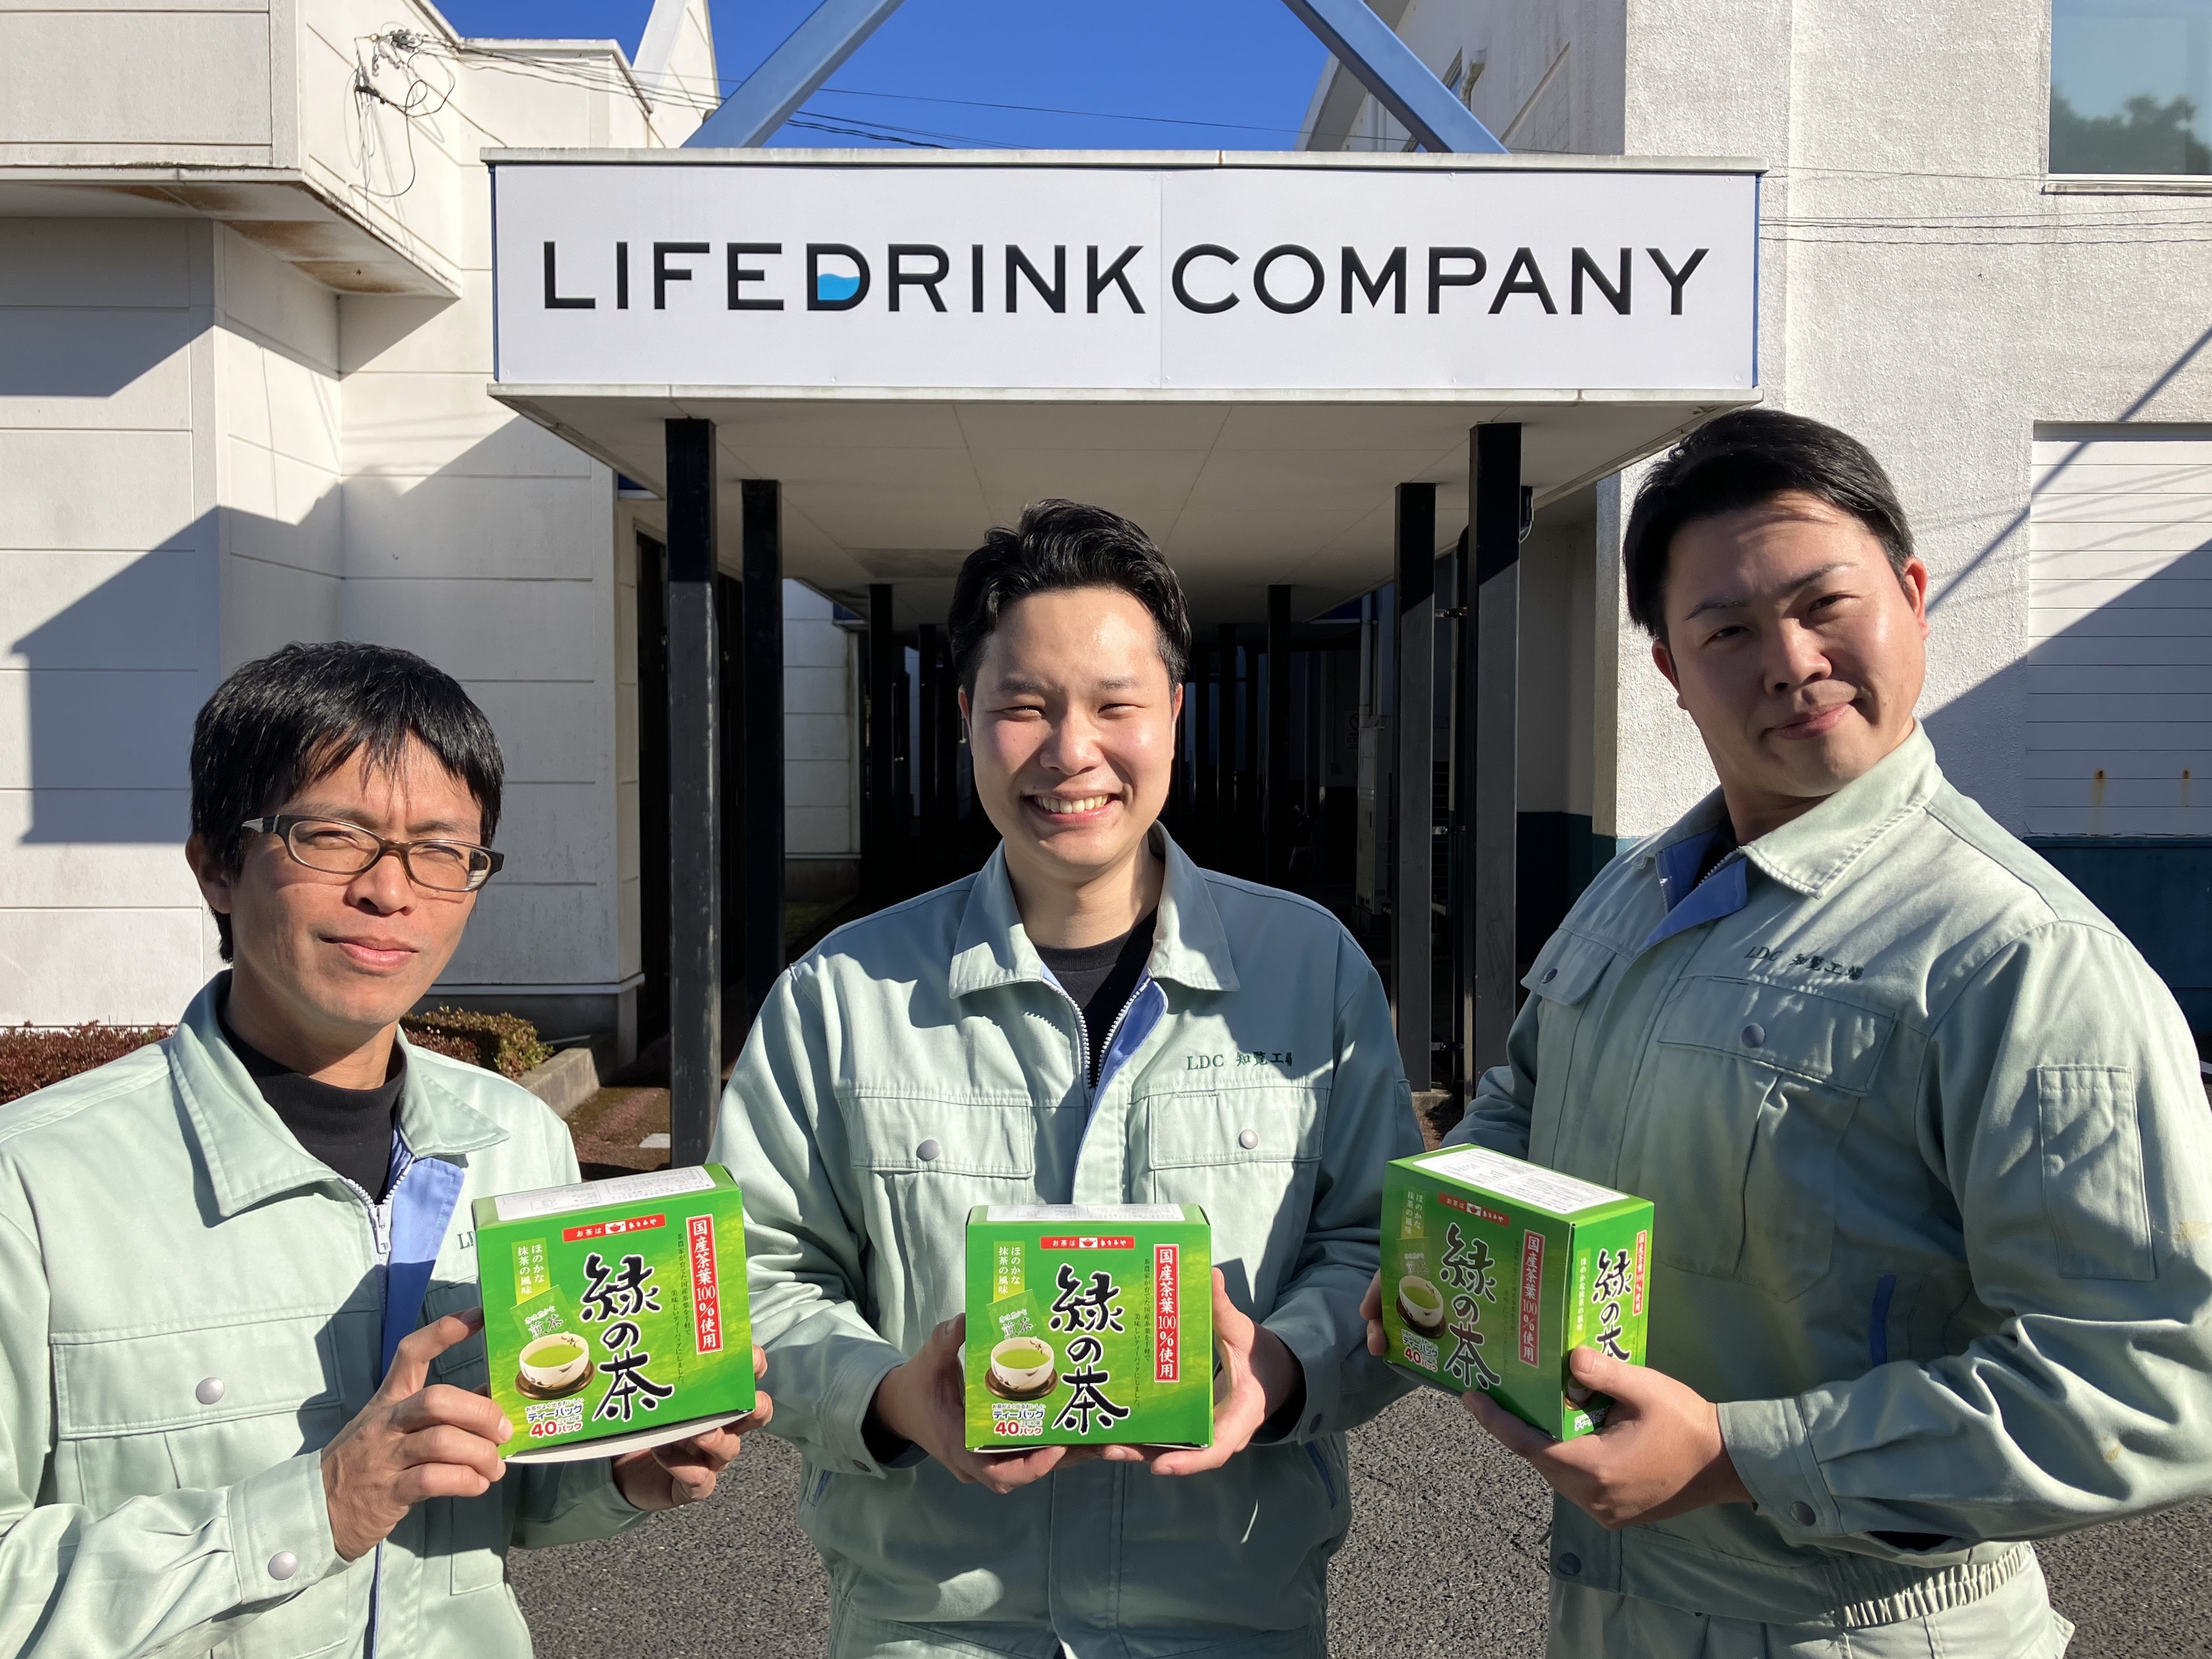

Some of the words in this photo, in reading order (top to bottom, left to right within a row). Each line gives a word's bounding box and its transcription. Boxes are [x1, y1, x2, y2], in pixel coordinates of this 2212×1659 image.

[544, 242, 1144, 313] LIFEDRINK
[1172, 245, 1708, 314] COMPANY
[1743, 946, 1783, 961] LDC
[1186, 1053, 1224, 1070] LDC
[576, 1227, 603, 1238] お茶は
[1413, 1194, 1423, 1230] ほのかな
[517, 1246, 533, 1295] 抹茶の風味
[531, 1244, 545, 1283] ほのかな
[692, 1220, 717, 1349] 国産茶葉100%使用
[998, 1246, 1008, 1295] 抹茶の風味
[1011, 1247, 1021, 1285] ほのかな
[1158, 1248, 1176, 1379] 国産茶葉100%使用
[1440, 1223, 1501, 1389] 緑の茶
[1522, 1235, 1540, 1362] 国産茶葉100%使用
[582, 1254, 674, 1422] 緑の茶
[1051, 1264, 1129, 1434] 緑の茶
[531, 1421, 582, 1436] 40パック
[995, 1421, 1042, 1435] 40パック
